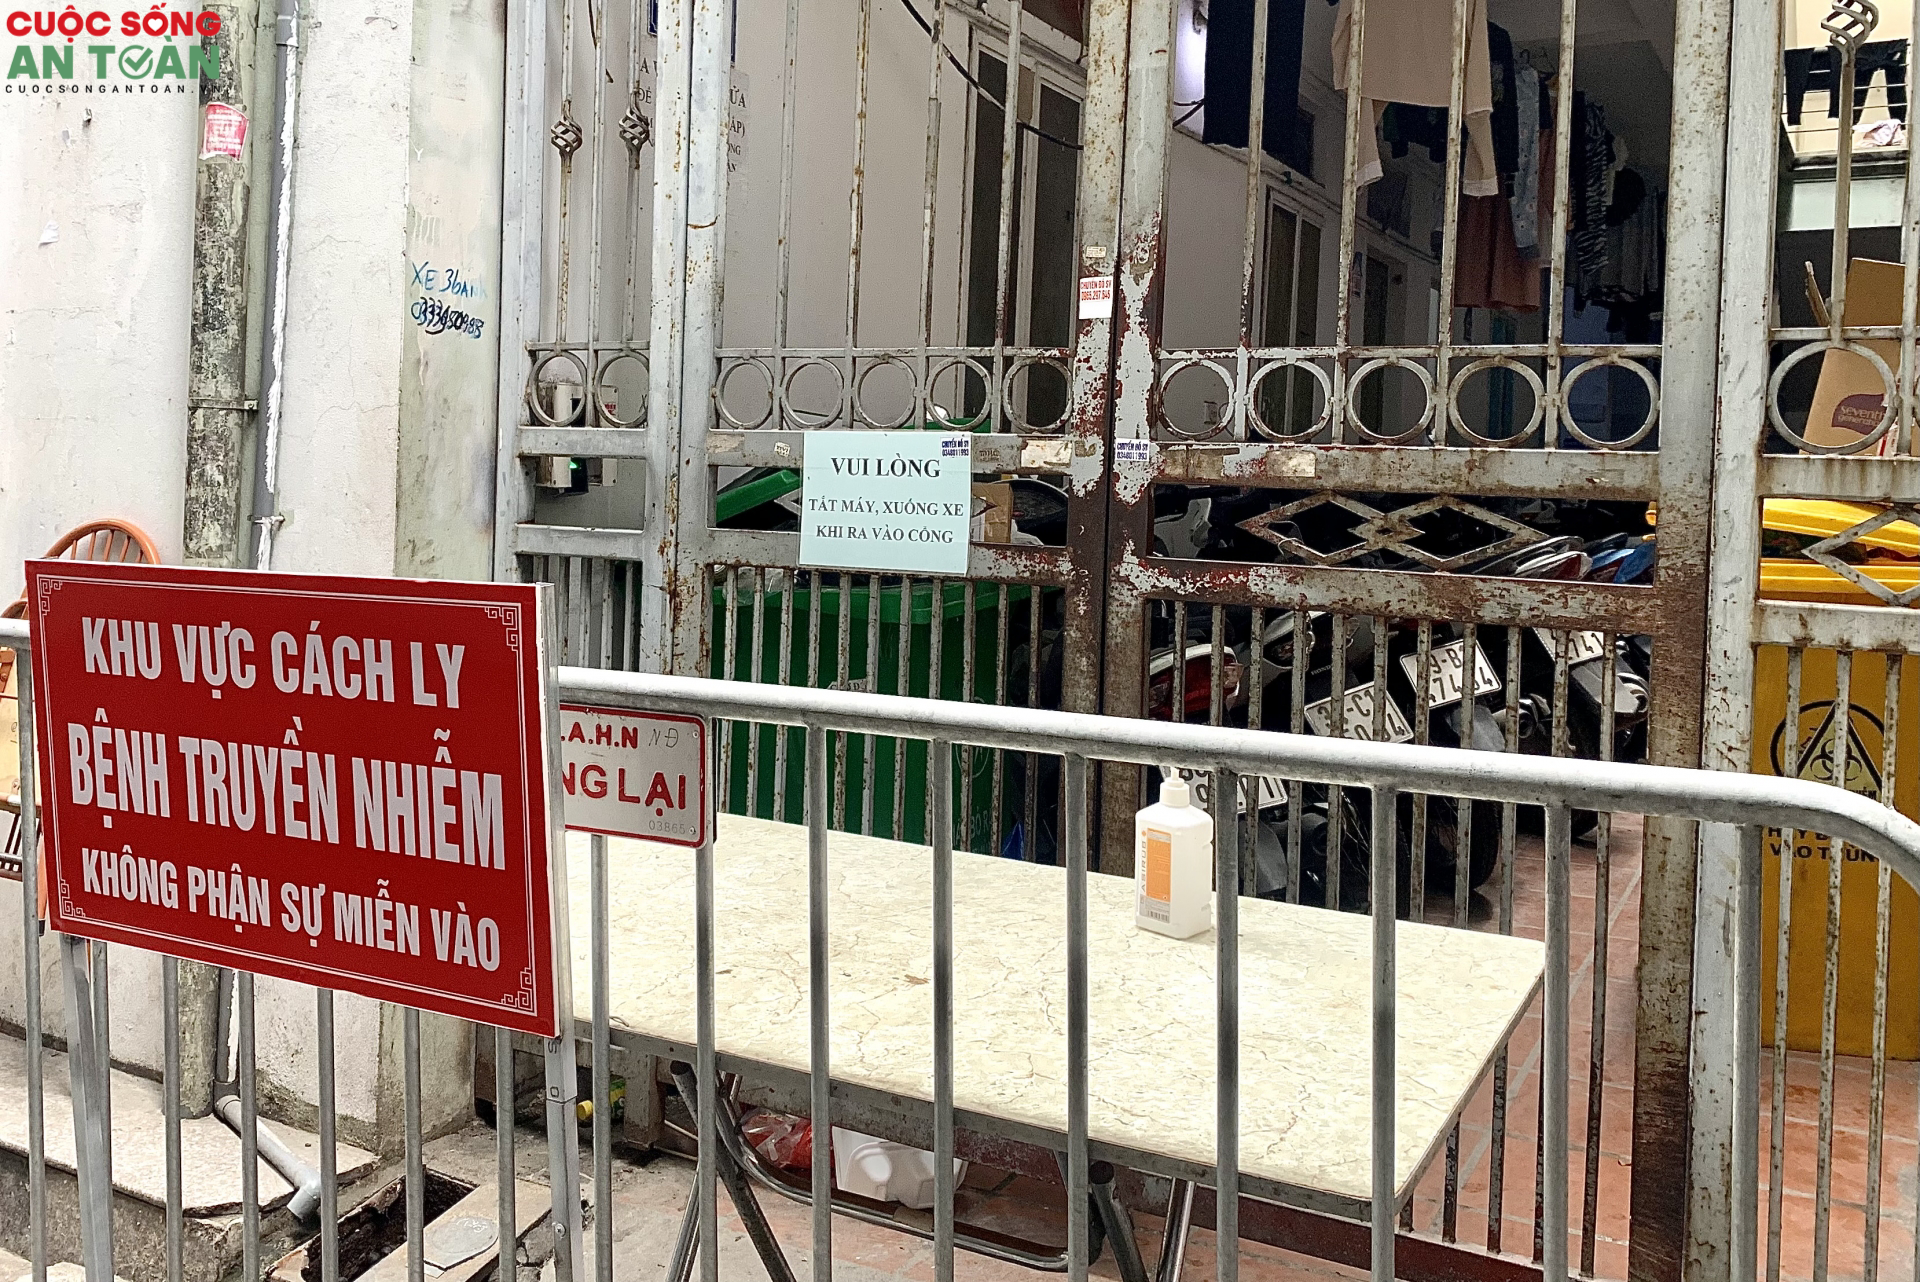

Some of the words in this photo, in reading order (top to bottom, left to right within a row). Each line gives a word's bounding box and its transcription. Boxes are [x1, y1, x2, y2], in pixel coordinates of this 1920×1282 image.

[411, 261, 438, 291] XE
[830, 457, 870, 476] VUI
[875, 452, 941, 478] LÒNG
[808, 495, 837, 512] TẮT
[841, 496, 879, 516] MÁY,
[882, 497, 939, 516] XUỐNG
[942, 503, 964, 517] XE
[815, 525, 843, 539] KHI
[847, 526, 868, 540] RA
[872, 524, 904, 542] VÀO
[907, 526, 954, 543] CỔNG
[81, 616, 162, 680] KHU
[171, 620, 257, 700] VỰC
[270, 620, 395, 703] CÁCH
[410, 641, 466, 709] LY
[1310, 665, 1332, 676] HOND
[560, 721, 639, 749] .A.H.N
[67, 707, 171, 829] BỆNH
[178, 715, 340, 845] TRUYỀN
[351, 727, 506, 871] NHIỄM
[562, 761, 608, 799] NG
[618, 767, 687, 817] LẠI
[648, 820, 686, 835] 03865
[81, 844, 179, 909] KHÔNG
[187, 862, 271, 934] PHẬN
[280, 882, 326, 948] SỰ
[332, 878, 421, 957] MIỄN
[429, 901, 501, 972] VÀO
